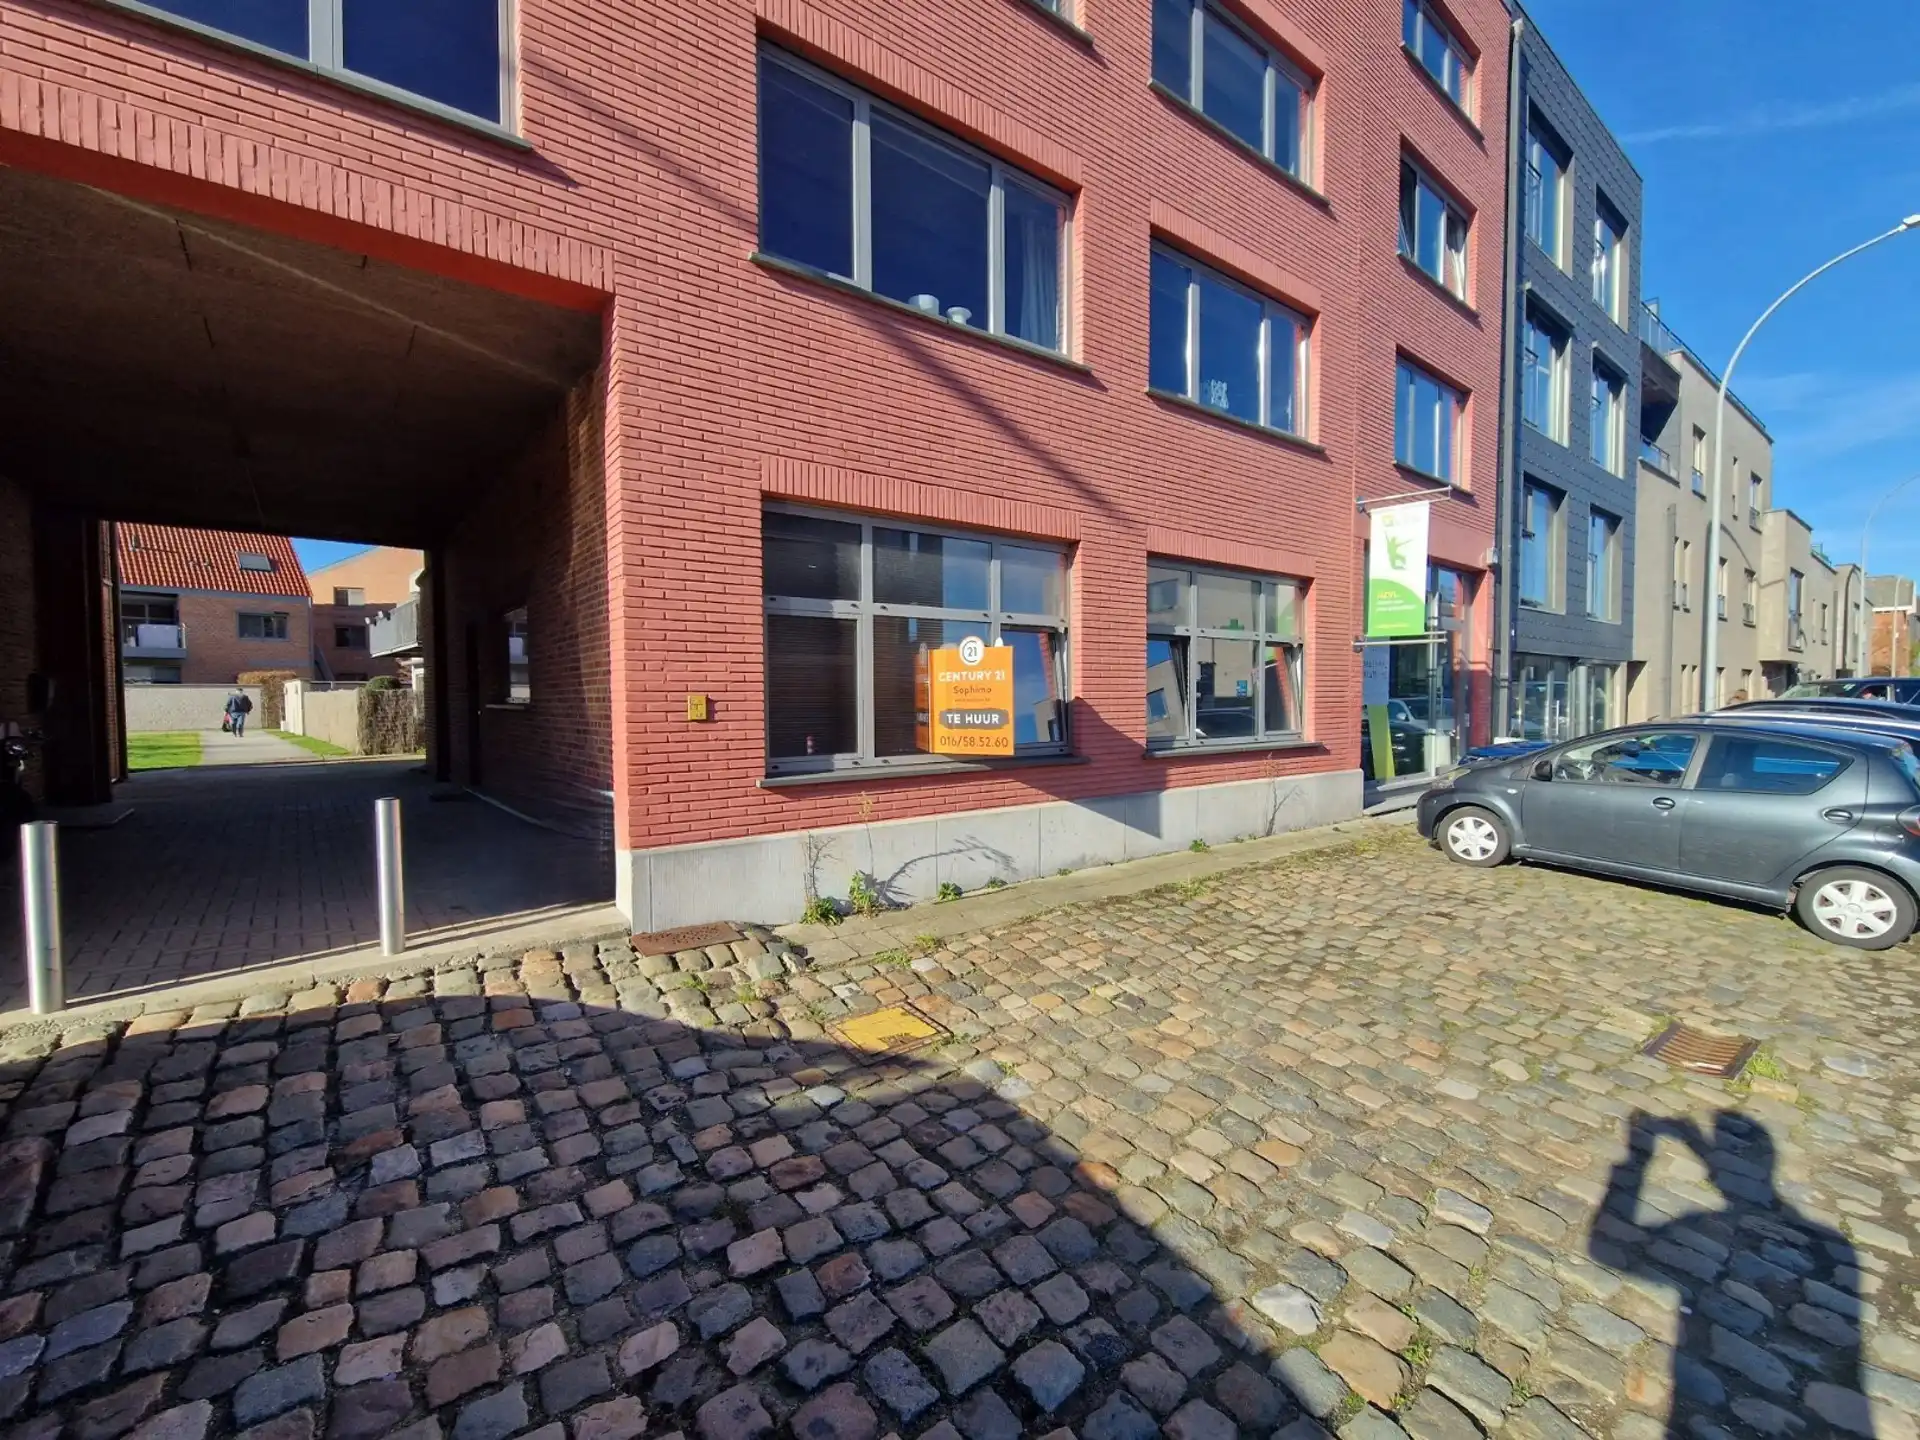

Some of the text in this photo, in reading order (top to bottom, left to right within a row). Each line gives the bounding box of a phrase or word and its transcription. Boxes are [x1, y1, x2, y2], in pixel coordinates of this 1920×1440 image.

[938, 670, 1005, 682] CENTURY 21
[946, 713, 1000, 725] TE HUUR
[939, 735, 1009, 748] 016/58.52.60
